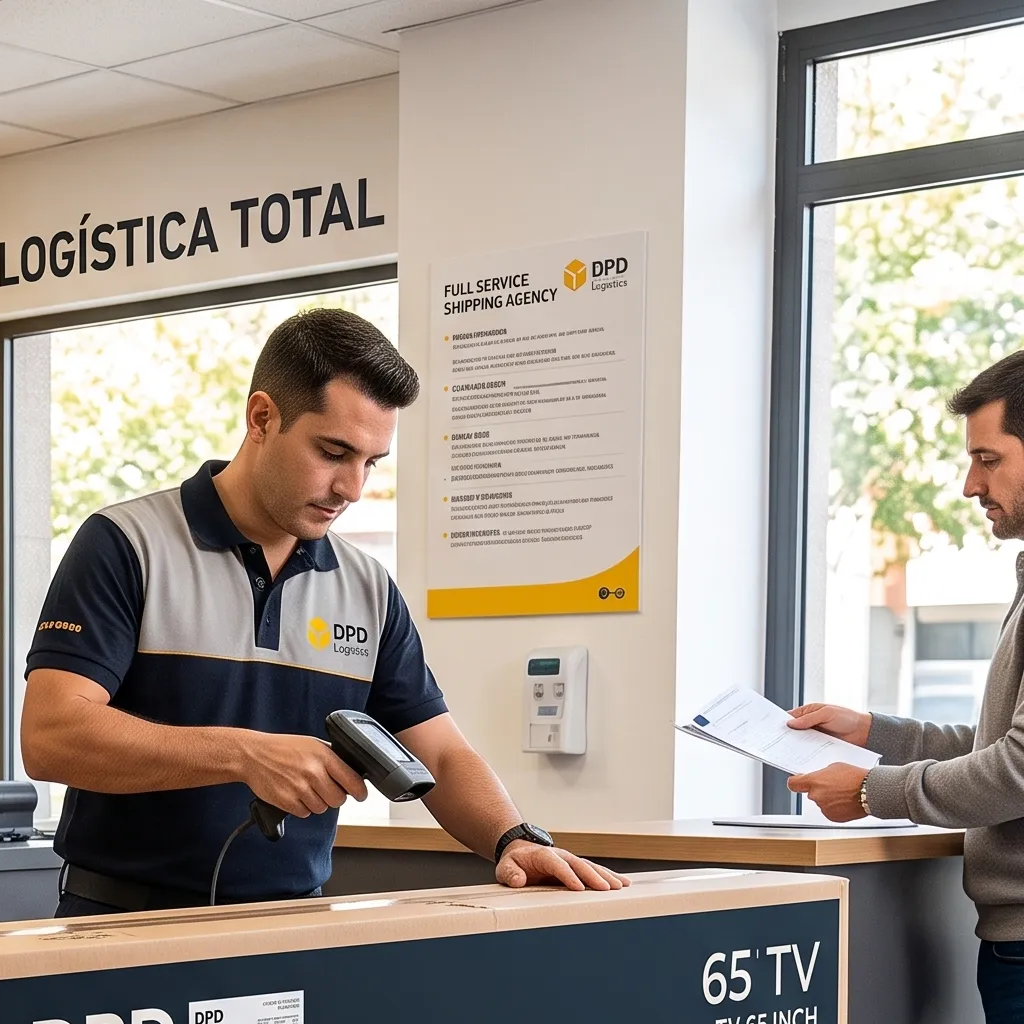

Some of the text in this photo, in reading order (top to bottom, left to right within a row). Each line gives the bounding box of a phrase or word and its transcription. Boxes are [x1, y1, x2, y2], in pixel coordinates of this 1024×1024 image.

[230, 178, 385, 249] TOTAL
[591, 257, 629, 278] DPD
[444, 273, 530, 298] FULL SERVICE
[591, 278, 628, 292] Logistics
[443, 288, 558, 316] SHIPPING AGENCY
[333, 623, 368, 644] DPD
[766, 941, 821, 996] TV
